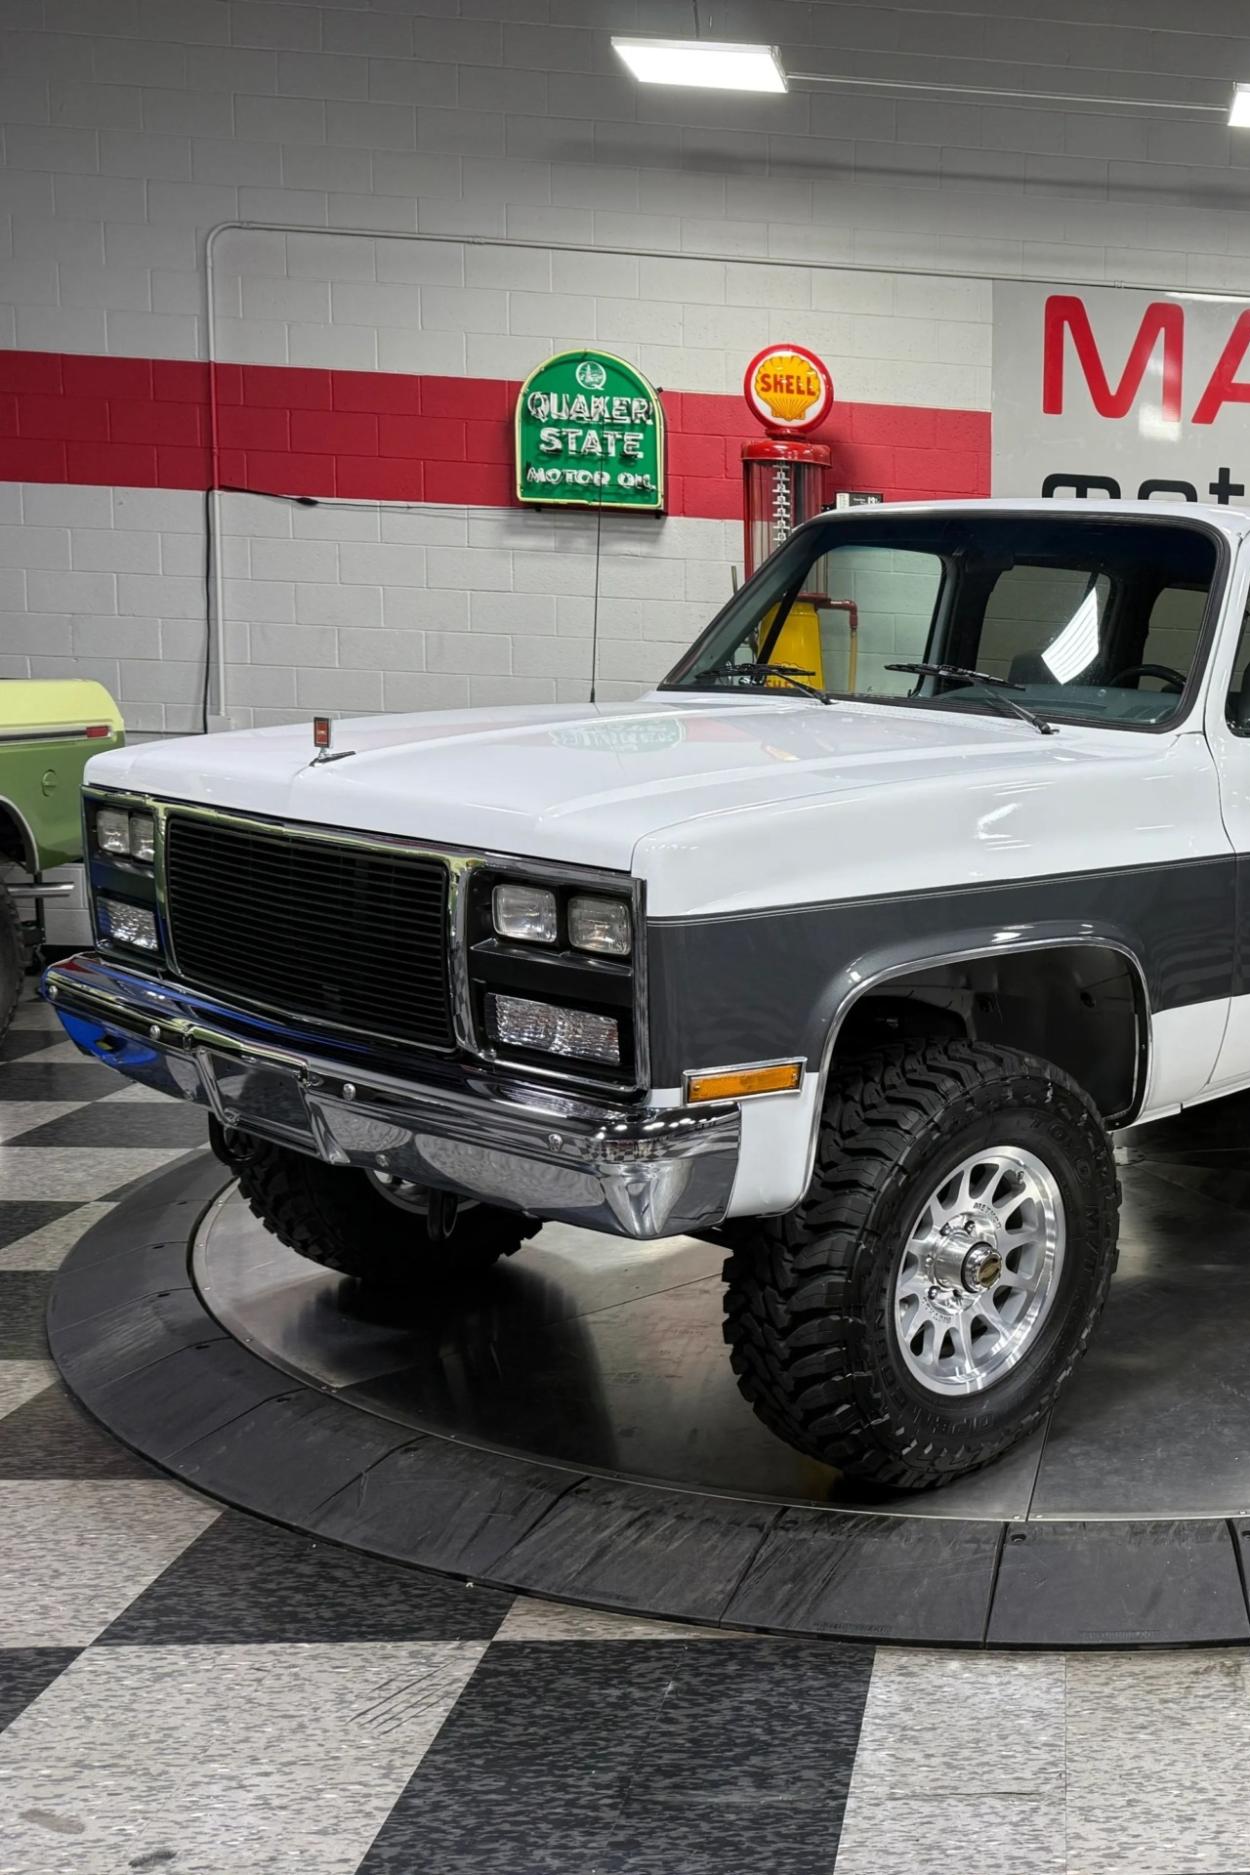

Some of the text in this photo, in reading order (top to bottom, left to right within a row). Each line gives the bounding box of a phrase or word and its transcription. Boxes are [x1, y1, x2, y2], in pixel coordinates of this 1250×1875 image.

[760, 373, 816, 396] SHELL
[527, 391, 654, 425] QUAKER
[539, 427, 645, 458] STATE
[527, 467, 656, 490] MOTOR OIL
